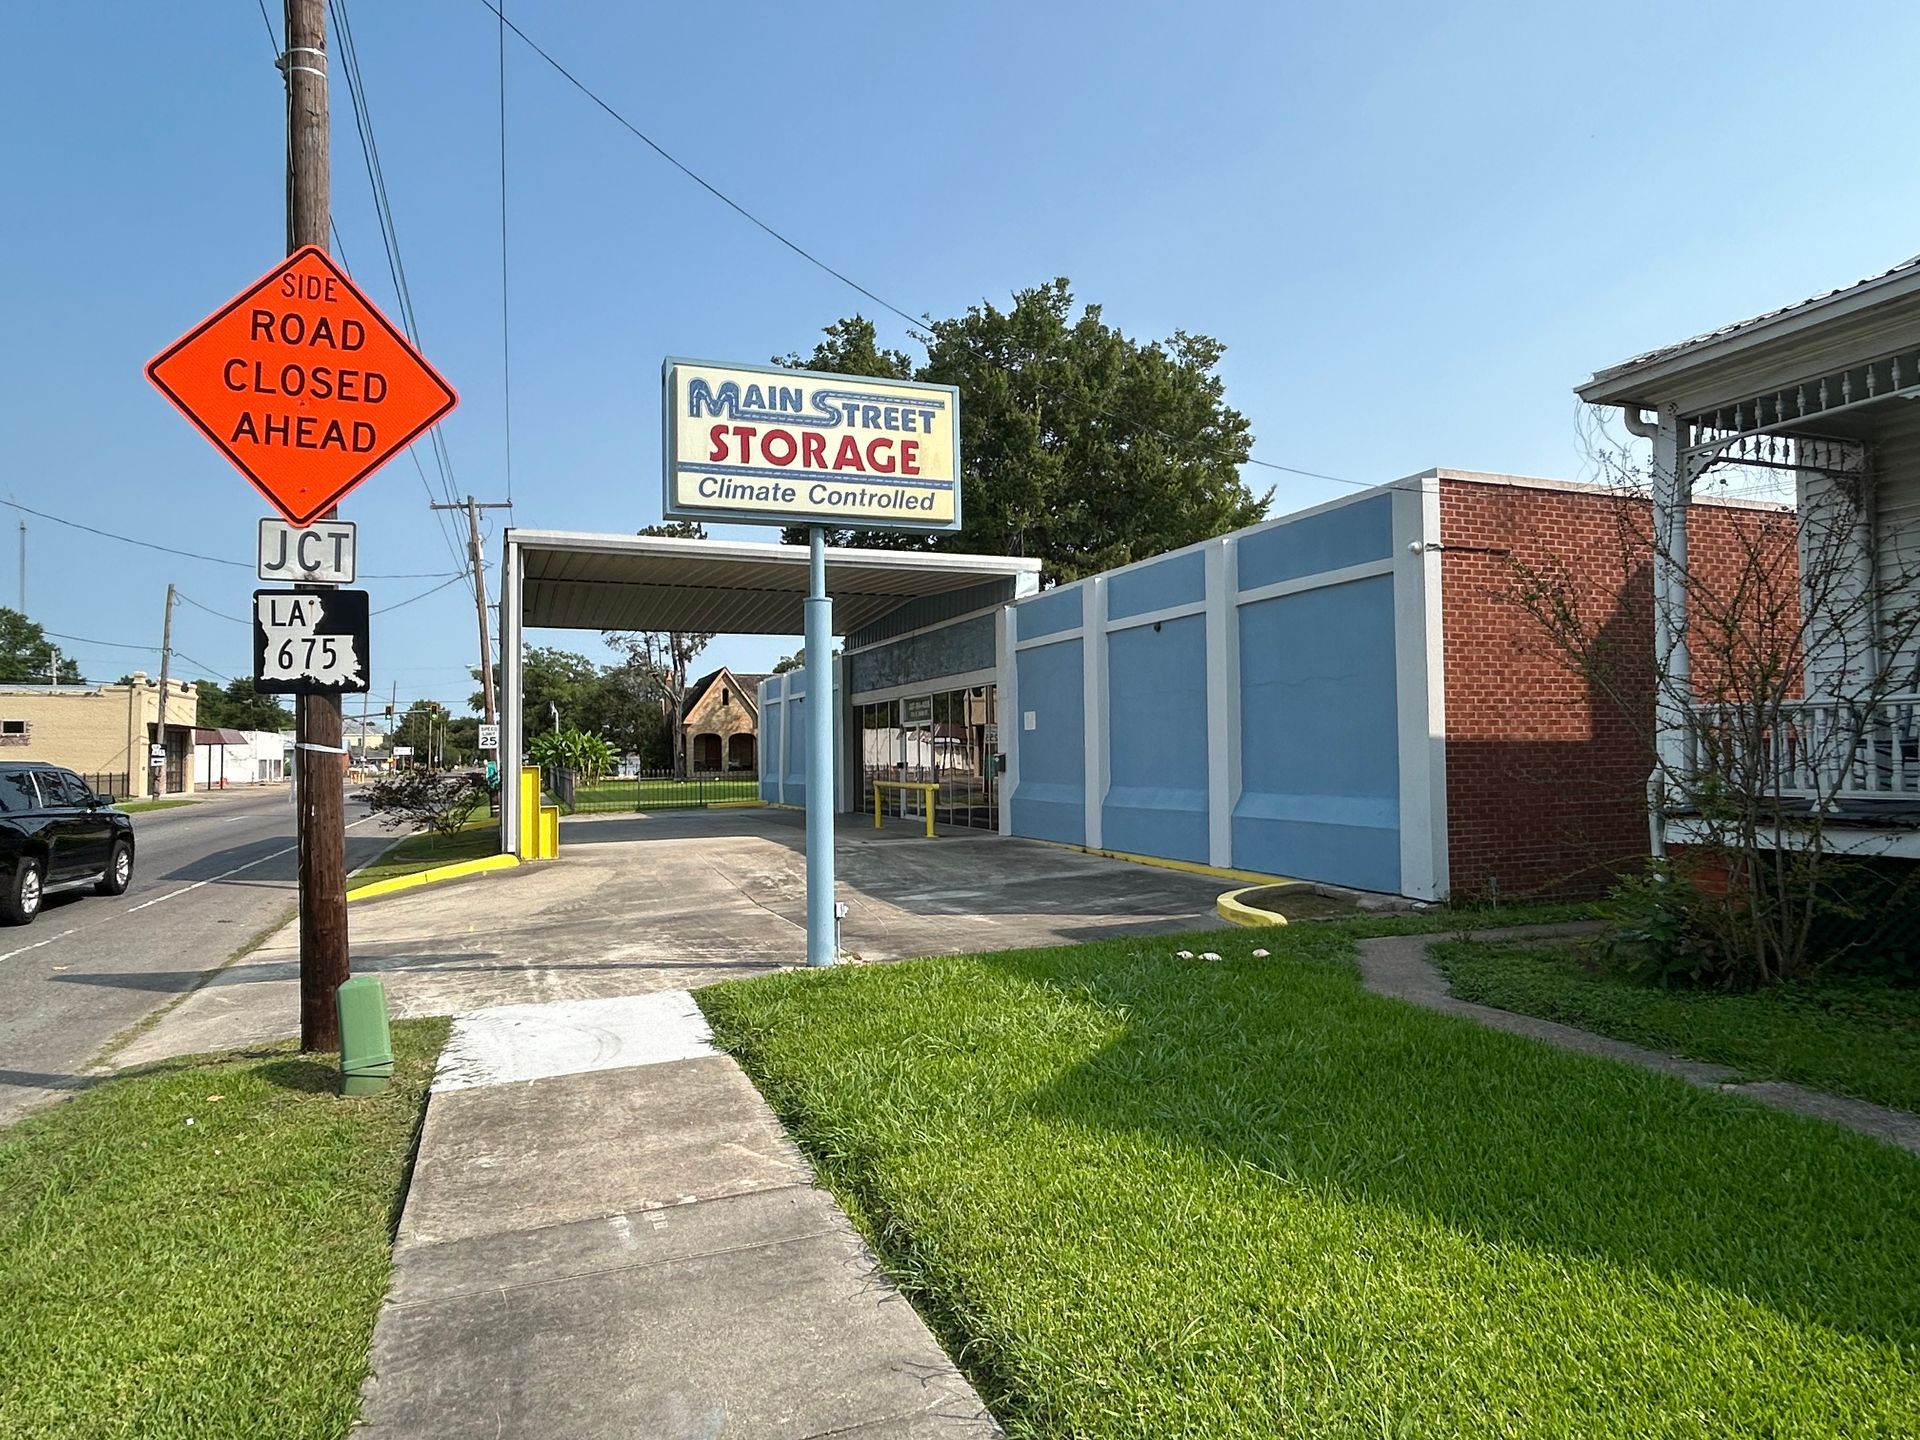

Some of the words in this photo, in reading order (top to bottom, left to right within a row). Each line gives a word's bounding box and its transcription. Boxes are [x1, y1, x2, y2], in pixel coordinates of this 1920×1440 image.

[281, 272, 338, 303] SIDE
[250, 308, 366, 352] ROAD
[223, 358, 388, 404] CLOSED
[688, 376, 803, 420] MAIN
[810, 389, 945, 434] STREET
[230, 411, 377, 454] AHEAD
[709, 424, 921, 475] STORAGE
[698, 476, 797, 504] Climate
[808, 484, 936, 512] Controlled
[263, 529, 350, 573] JCT
[270, 599, 307, 627] LA
[277, 637, 337, 670] 675
[481, 736, 498, 746] 25
